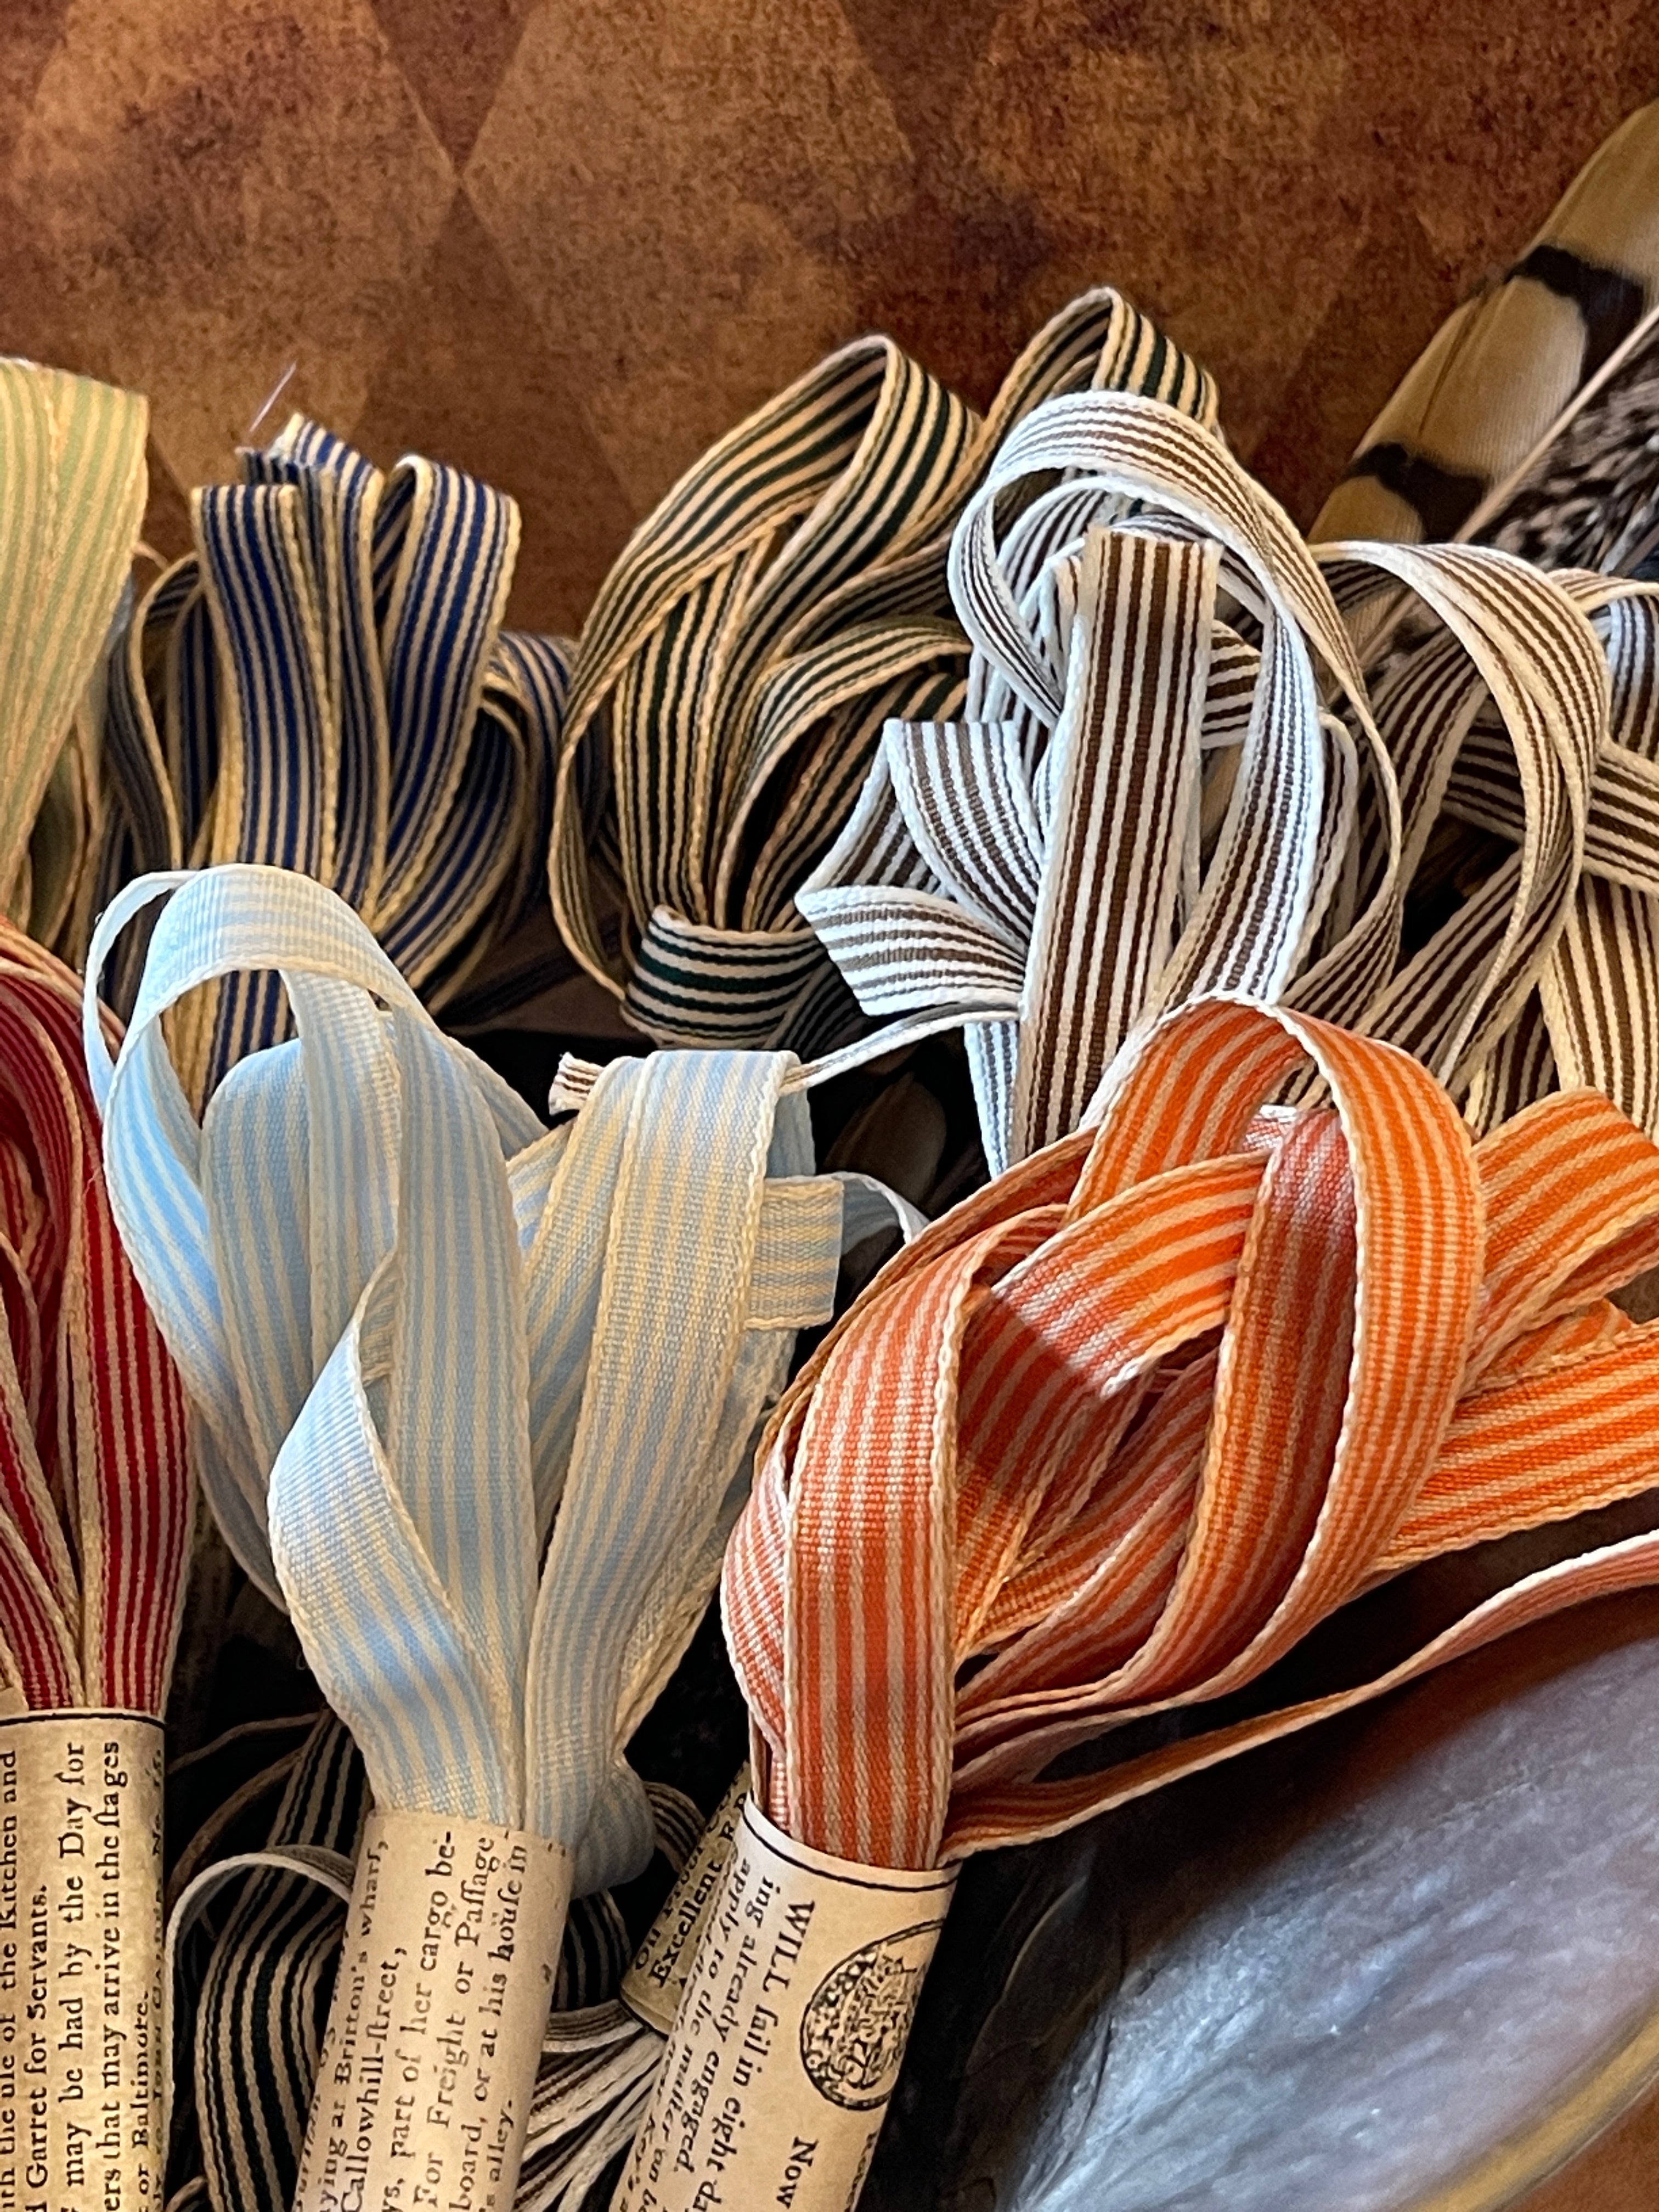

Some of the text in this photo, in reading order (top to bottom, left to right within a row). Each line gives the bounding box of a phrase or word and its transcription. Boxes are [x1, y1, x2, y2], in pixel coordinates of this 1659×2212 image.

[0, 1750, 16, 1803] and
[53, 1741, 85, 1786] for
[58, 1797, 92, 1859] Day
[425, 1831, 455, 1877] be-
[0, 1815, 17, 1929] Kitchen
[95, 1835, 120, 1881] the
[503, 1845, 528, 1874] in
[58, 1875, 84, 1923] the
[95, 1891, 120, 1918] in
[647, 1860, 723, 1989] Excellent
[719, 1858, 751, 1943] apply
[26, 1884, 48, 2020] Servants.
[420, 1890, 458, 1971] cargo
[763, 1900, 815, 1992] WILL
[1, 1943, 17, 1990] the
[58, 1943, 92, 1978] by
[95, 1926, 120, 2016] arrive
[454, 1961, 474, 1994] or
[709, 1949, 725, 1979] to
[399, 1982, 432, 2035] her
[478, 1972, 507, 2017] his
[690, 1989, 712, 2036] the
[58, 1997, 83, 2050] had
[479, 2028, 498, 2058] at
[673, 1875, 781, 2173] ing already engaged.
[24, 2032, 47, 2075] for
[101, 2023, 127, 2089] may
[129, 1990, 149, 2149] Baltimore.
[394, 2047, 421, 2083] of
[426, 2012, 469, 2129] Freight
[733, 2055, 763, 2087] in
[58, 2068, 83, 2103] be
[473, 2067, 491, 2102] or
[0, 2109, 15, 2155] the
[26, 2086, 48, 2188] Garret
[95, 2100, 121, 2160] that
[331, 2098, 346, 2128] at
[390, 2094, 416, 2158] part
[707, 2097, 746, 2172] eight
[66, 2121, 92, 2187] may
[449, 2116, 488, 2211] board,
[487, 2100, 514, 2182] alley.
[138, 2163, 149, 2195] or
[413, 2151, 443, 2208] For
[686, 2179, 723, 2212] da
